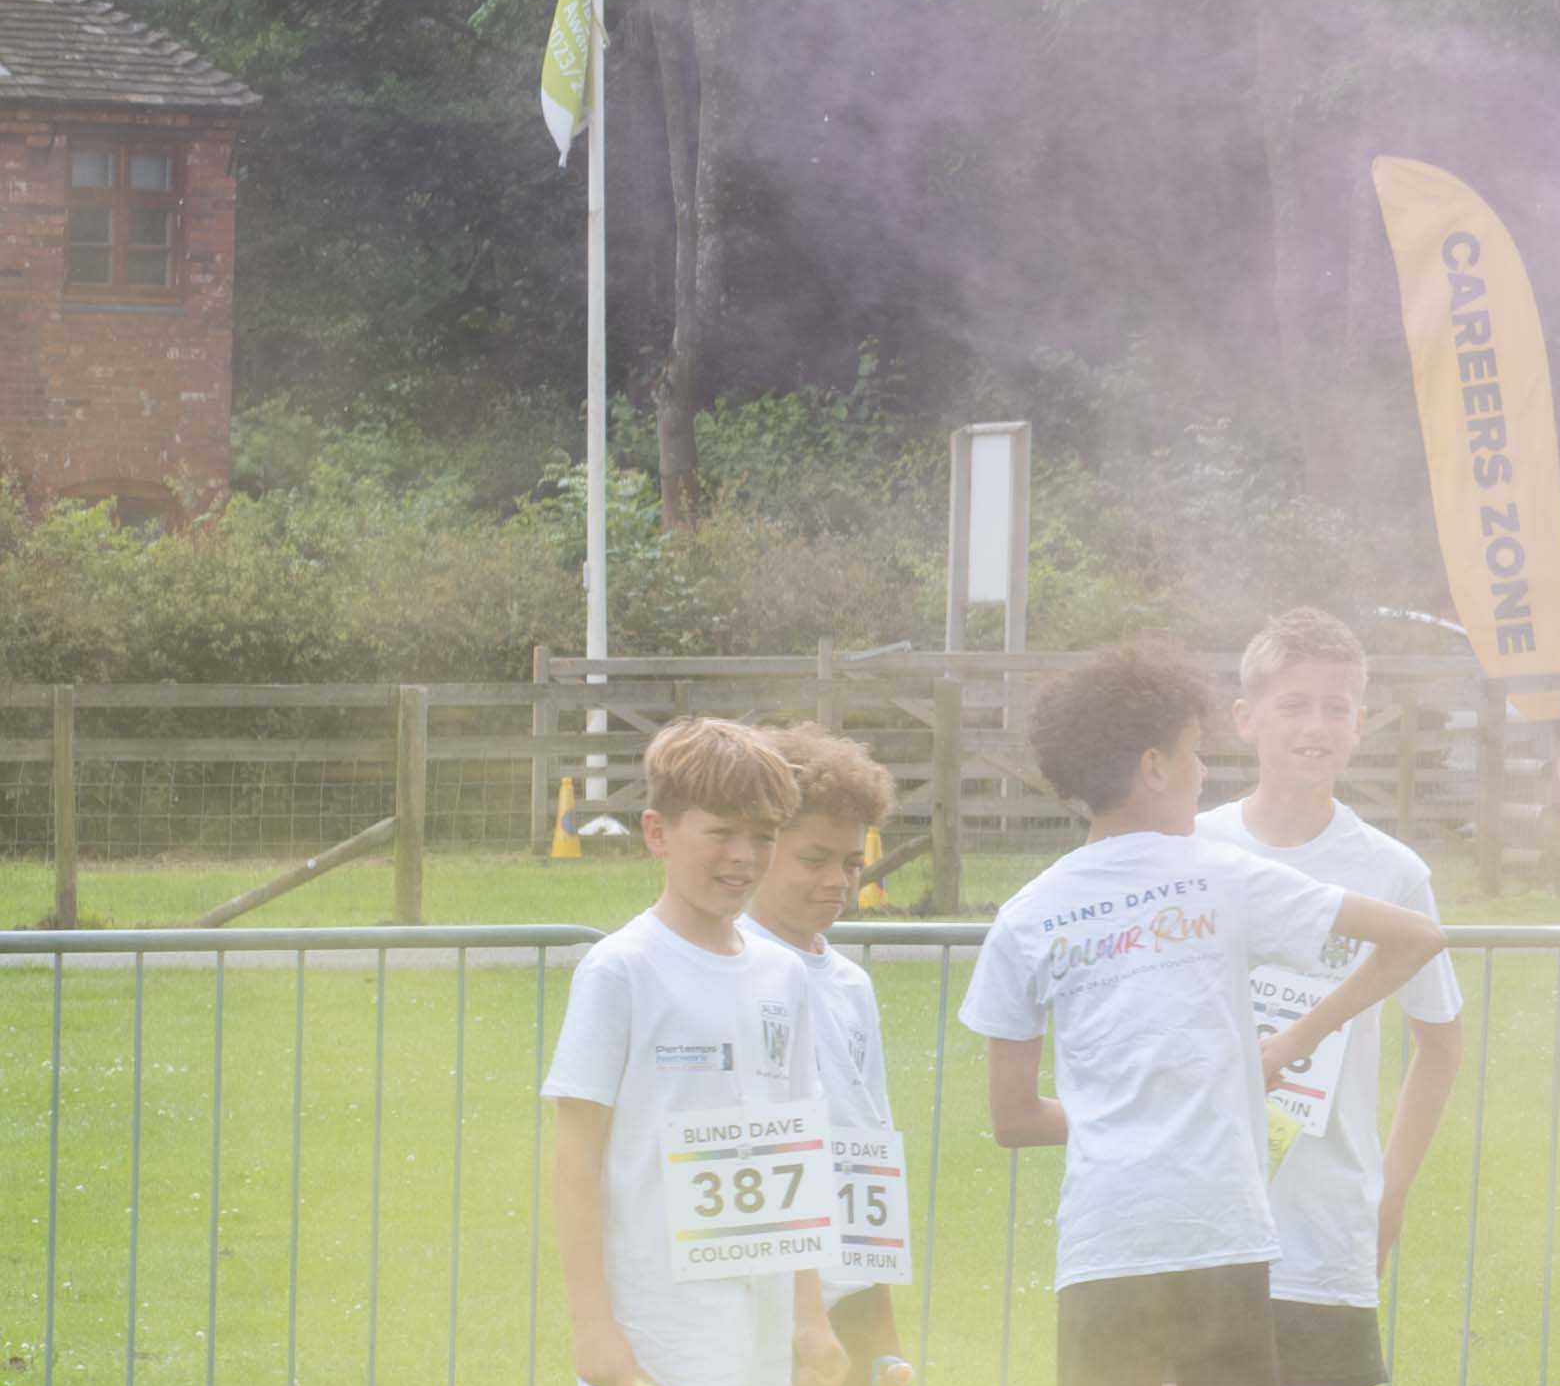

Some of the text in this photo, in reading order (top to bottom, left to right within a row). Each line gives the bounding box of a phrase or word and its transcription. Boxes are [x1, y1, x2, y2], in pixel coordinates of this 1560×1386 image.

[1442, 230, 1537, 656] CAREERS ZONE
[1043, 878, 1209, 933] BLIND DAVE'S
[1282, 987, 1321, 1008] DAV
[655, 1044, 718, 1056] Pertemps
[683, 1118, 805, 1144] BLIND DAVE
[851, 1141, 888, 1160] DAVE
[691, 1163, 805, 1218] 387
[837, 1182, 888, 1227] 15
[688, 1236, 823, 1265] COLOUR RUN
[867, 1250, 897, 1269] RUN
